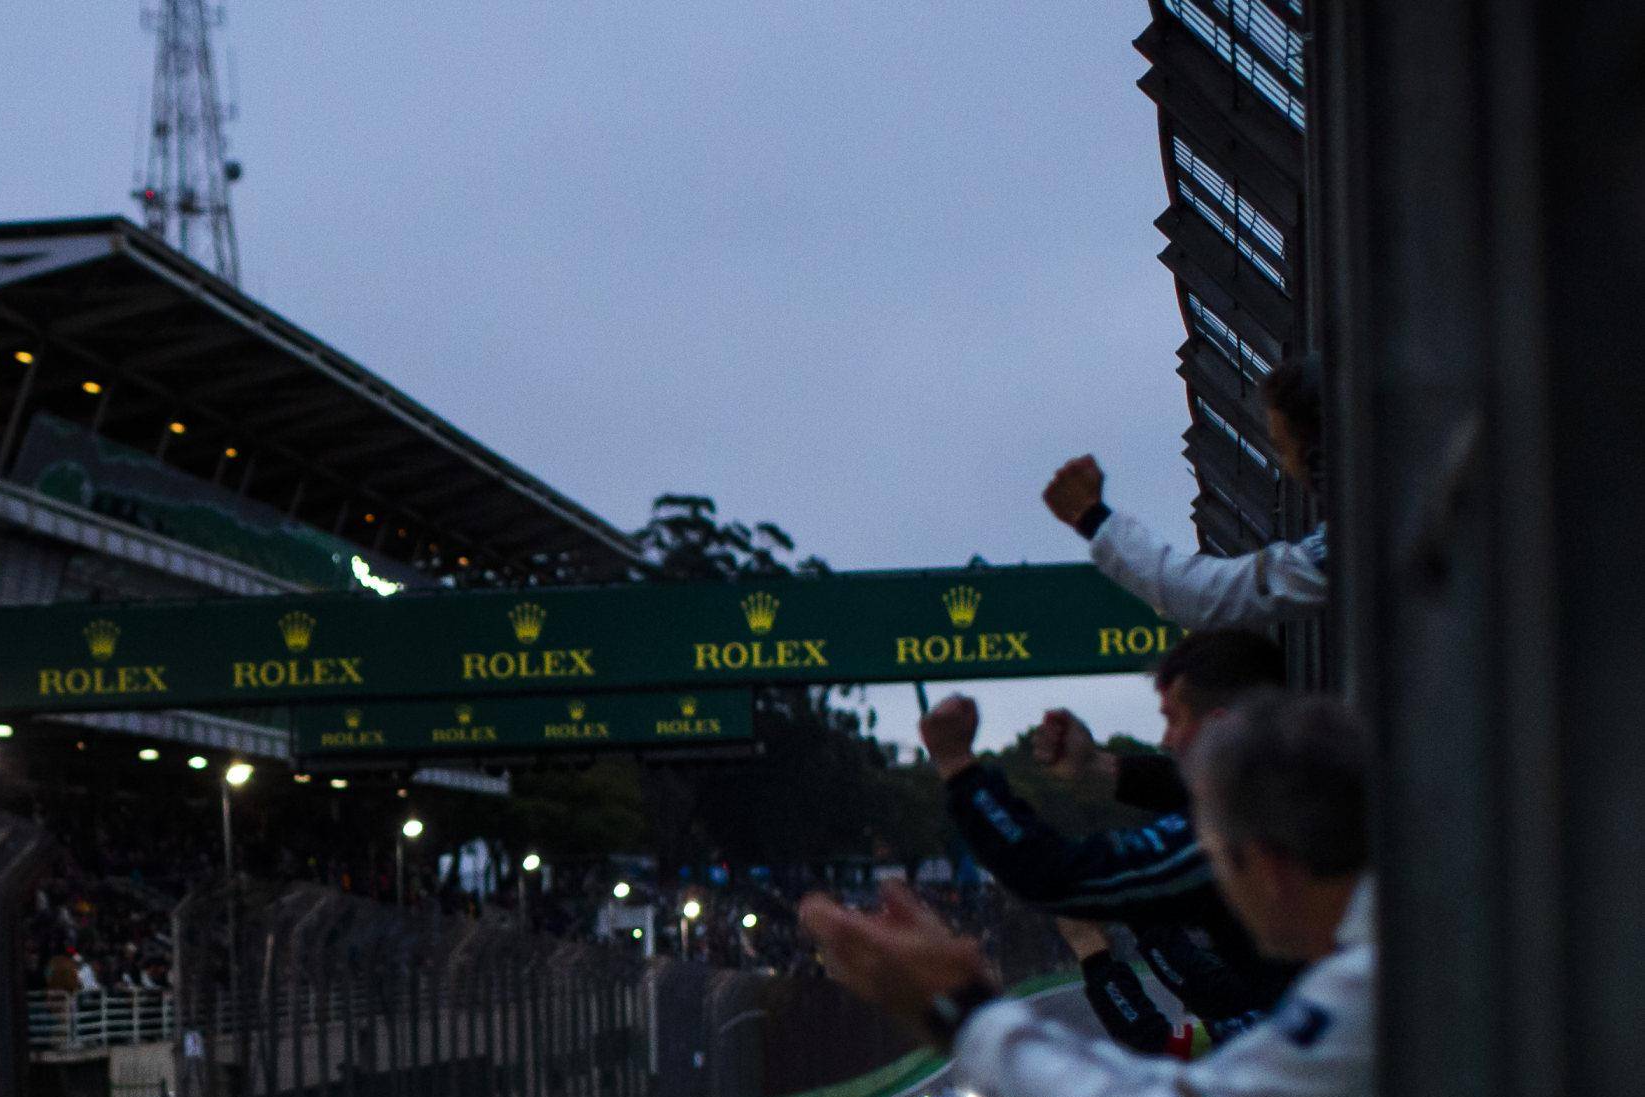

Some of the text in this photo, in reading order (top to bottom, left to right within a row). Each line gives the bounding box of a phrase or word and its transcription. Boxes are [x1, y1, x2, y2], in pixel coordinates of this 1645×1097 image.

[694, 639, 829, 670] ROLEX
[896, 631, 1031, 665] ROLEX
[1098, 625, 1192, 657] ROL
[232, 656, 363, 689] ROLEX
[461, 648, 595, 680] ROLEX
[38, 665, 169, 697] ROLEX
[321, 728, 385, 748] ROLEX
[433, 725, 498, 743] ROLEX
[545, 721, 609, 739] ROLEX
[656, 718, 721, 735] ROLEX
